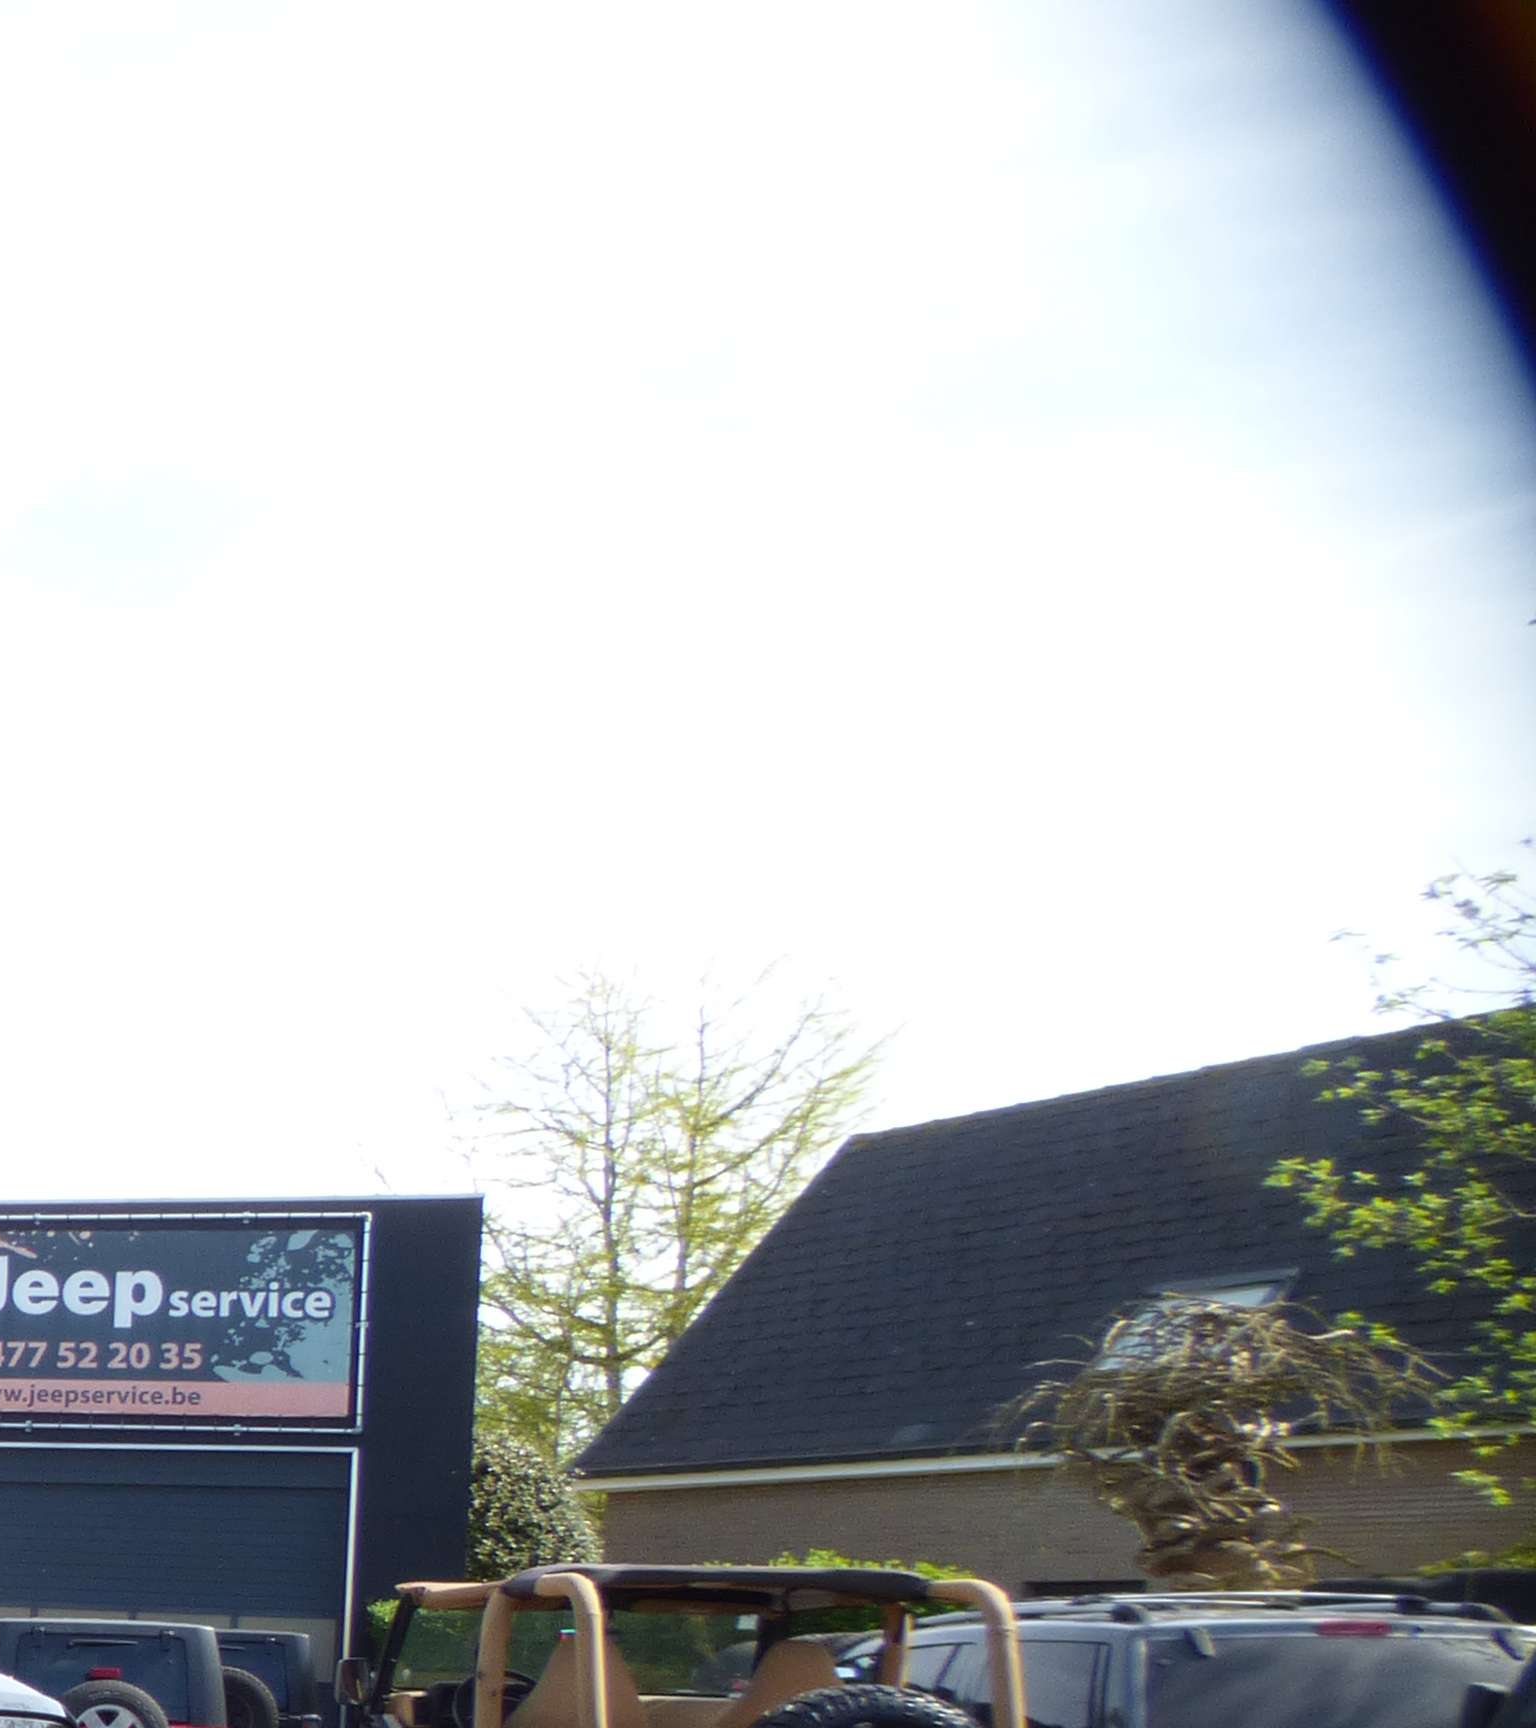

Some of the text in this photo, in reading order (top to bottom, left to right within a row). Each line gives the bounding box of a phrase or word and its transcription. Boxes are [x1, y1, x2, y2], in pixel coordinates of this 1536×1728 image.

[168, 1281, 333, 1318] service
[56, 1342, 99, 1369] 52
[107, 1342, 151, 1369] 20
[159, 1343, 202, 1370] 35
